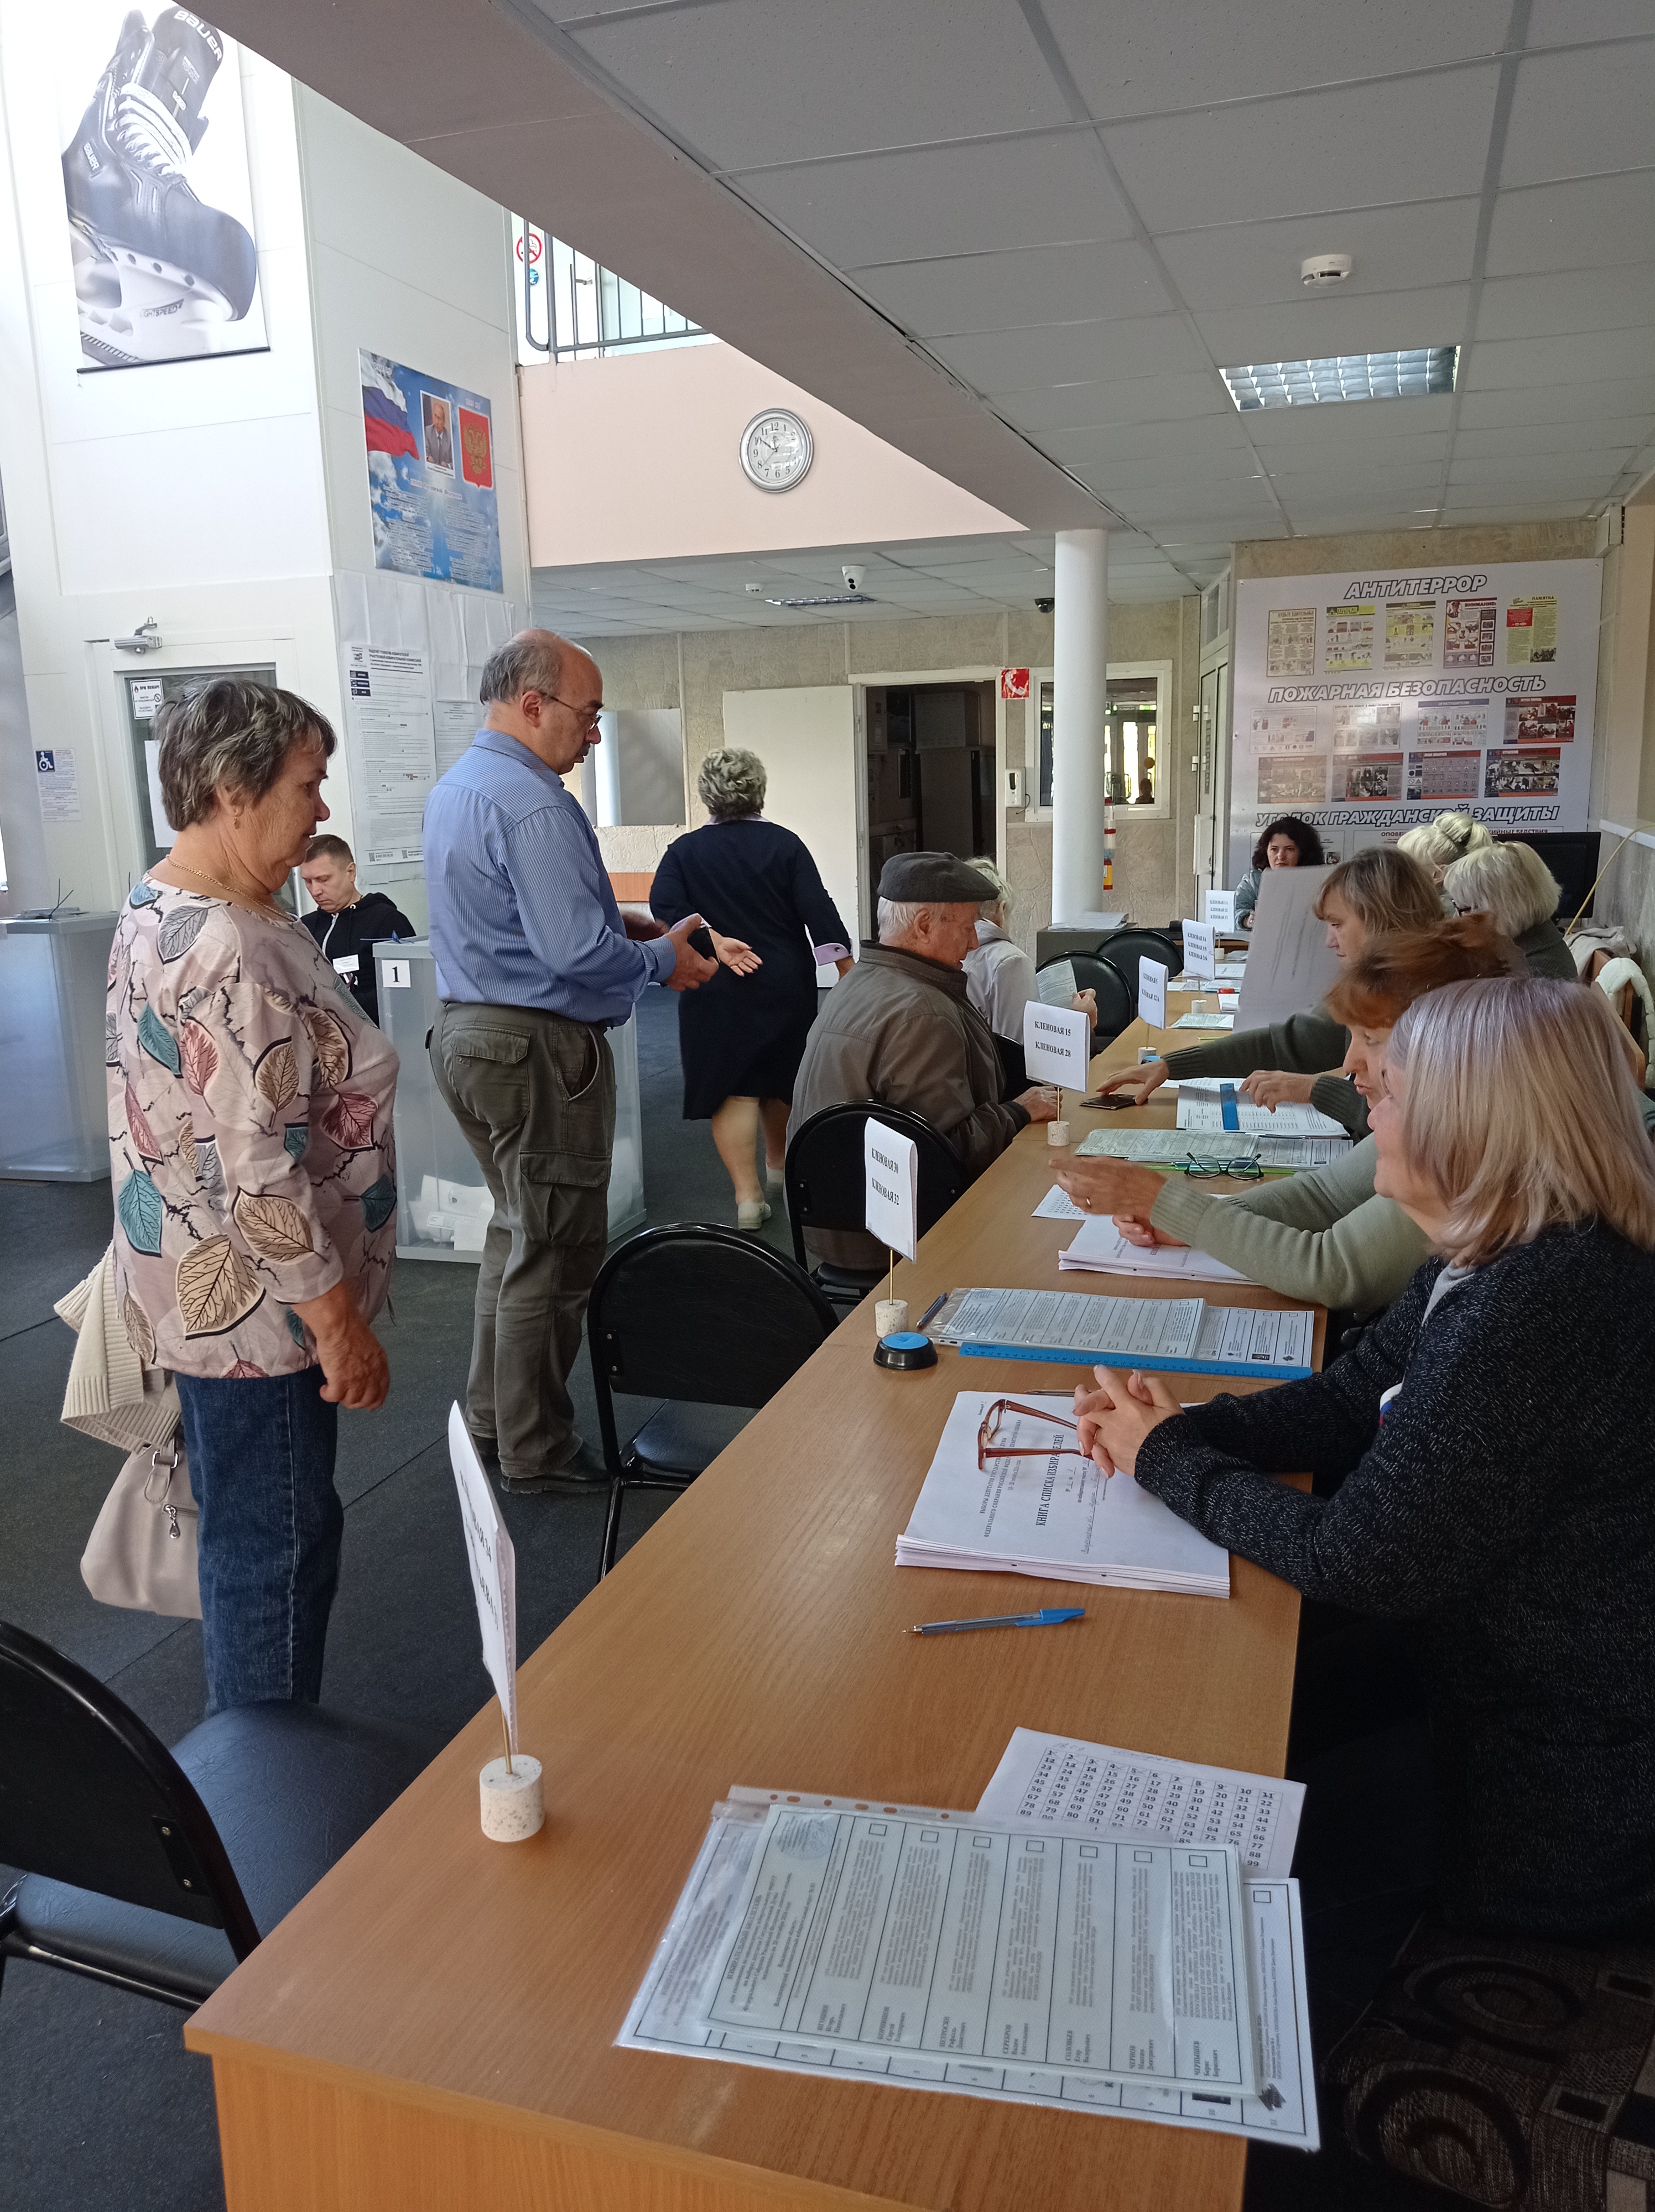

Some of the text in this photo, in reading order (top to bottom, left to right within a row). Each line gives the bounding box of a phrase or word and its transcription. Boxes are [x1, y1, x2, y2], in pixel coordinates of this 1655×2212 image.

[771, 422, 779, 431] 12
[754, 436, 762, 445] 10
[753, 449, 758, 457] 9
[765, 468, 769, 477] 7
[776, 469, 780, 478] 6
[1343, 574, 1487, 600] АНТИТЕРРОР
[1267, 675, 1547, 703] ПОЖАРНАЯ БЕЗОПАСНОСТЬ
[1472, 806, 1560, 824] ЗАЩИТЫ
[392, 966, 400, 982] 1
[1035, 1021, 1064, 1035] КЛЕНОВАЯ
[1035, 1041, 1064, 1056] КЛЕНОВАЯ
[872, 1147, 899, 1173] КЛЕНОВАЯ 30
[872, 1178, 899, 1205] КЛЕНОВАЯ 32
[1035, 1434, 1064, 1526] КНИГА СПИСКА ИЗБИРАЕЛЕЙ
[984, 1509, 996, 1537] ФЕДЕРАЛЬНОГО
[992, 1489, 1002, 1508] СОБРАНИЯ
